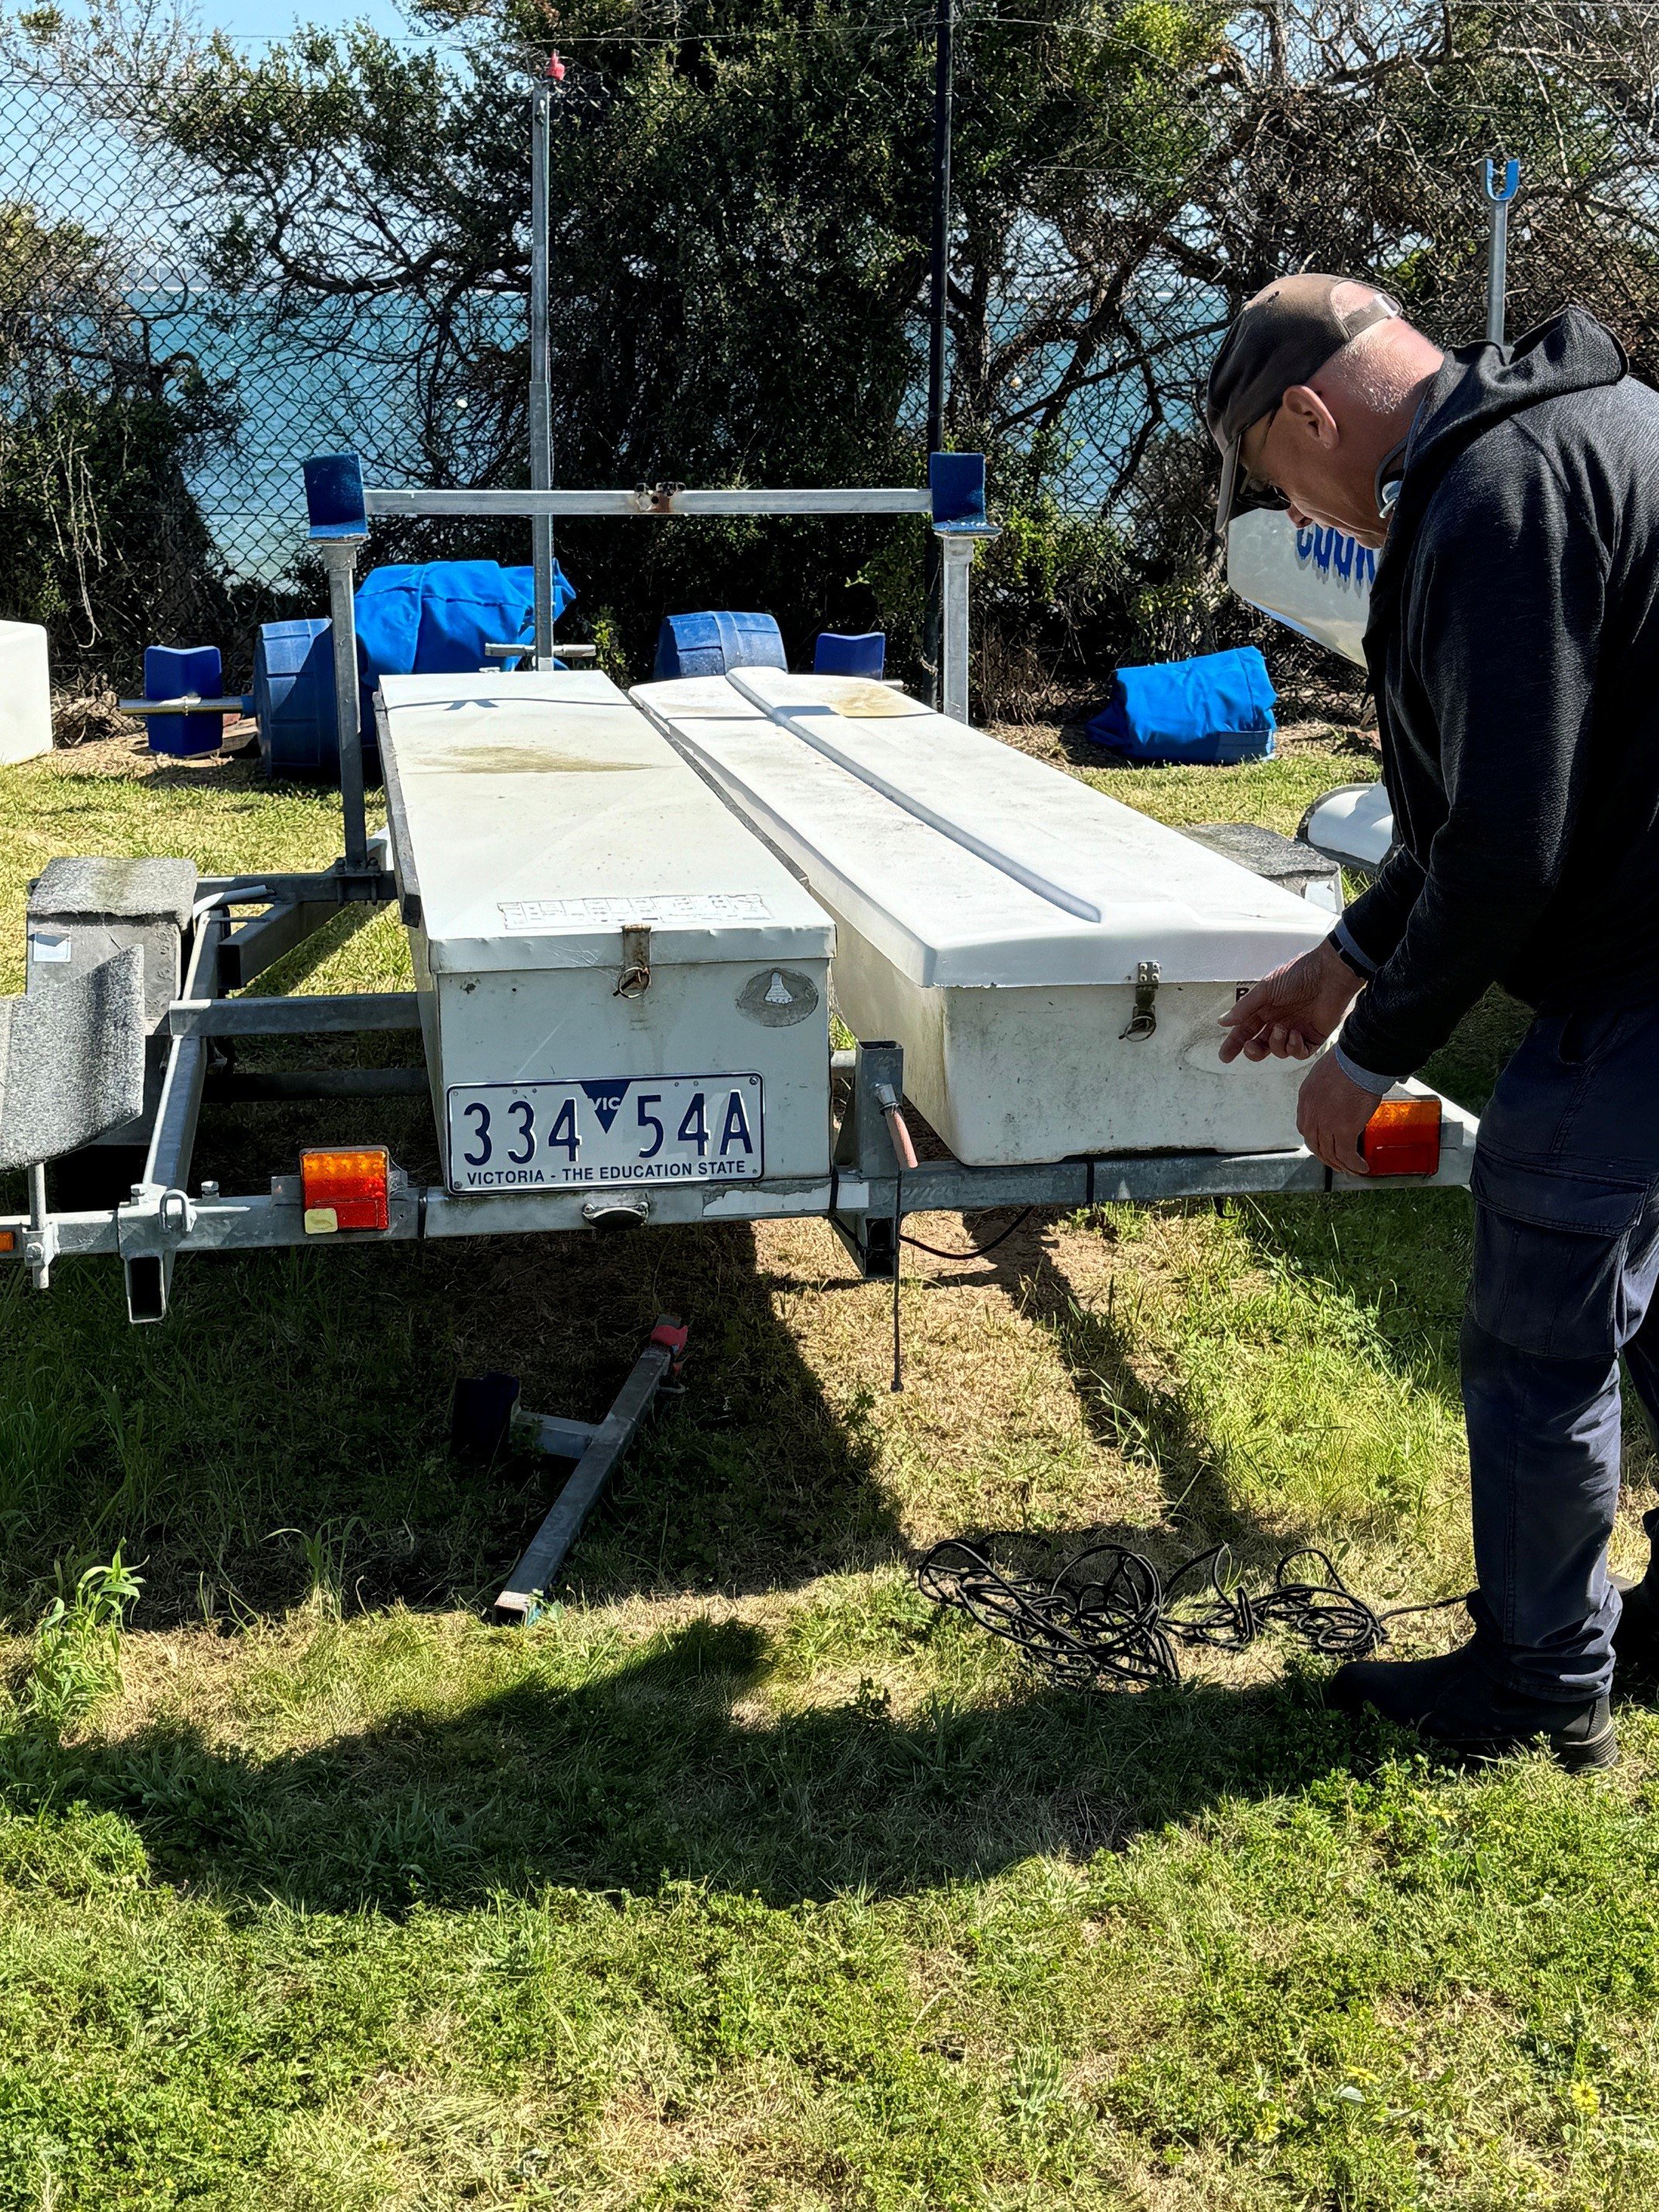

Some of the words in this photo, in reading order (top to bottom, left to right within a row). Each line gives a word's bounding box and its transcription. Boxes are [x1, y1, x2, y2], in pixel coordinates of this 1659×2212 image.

[588, 1097, 620, 1111] VIC
[464, 1098, 582, 1166] 334
[637, 1090, 753, 1158] 54A
[467, 1170, 544, 1185] VICTORIA
[562, 1167, 593, 1181] THE
[599, 1163, 692, 1180] EDUCATION
[698, 1160, 746, 1175] STATE
